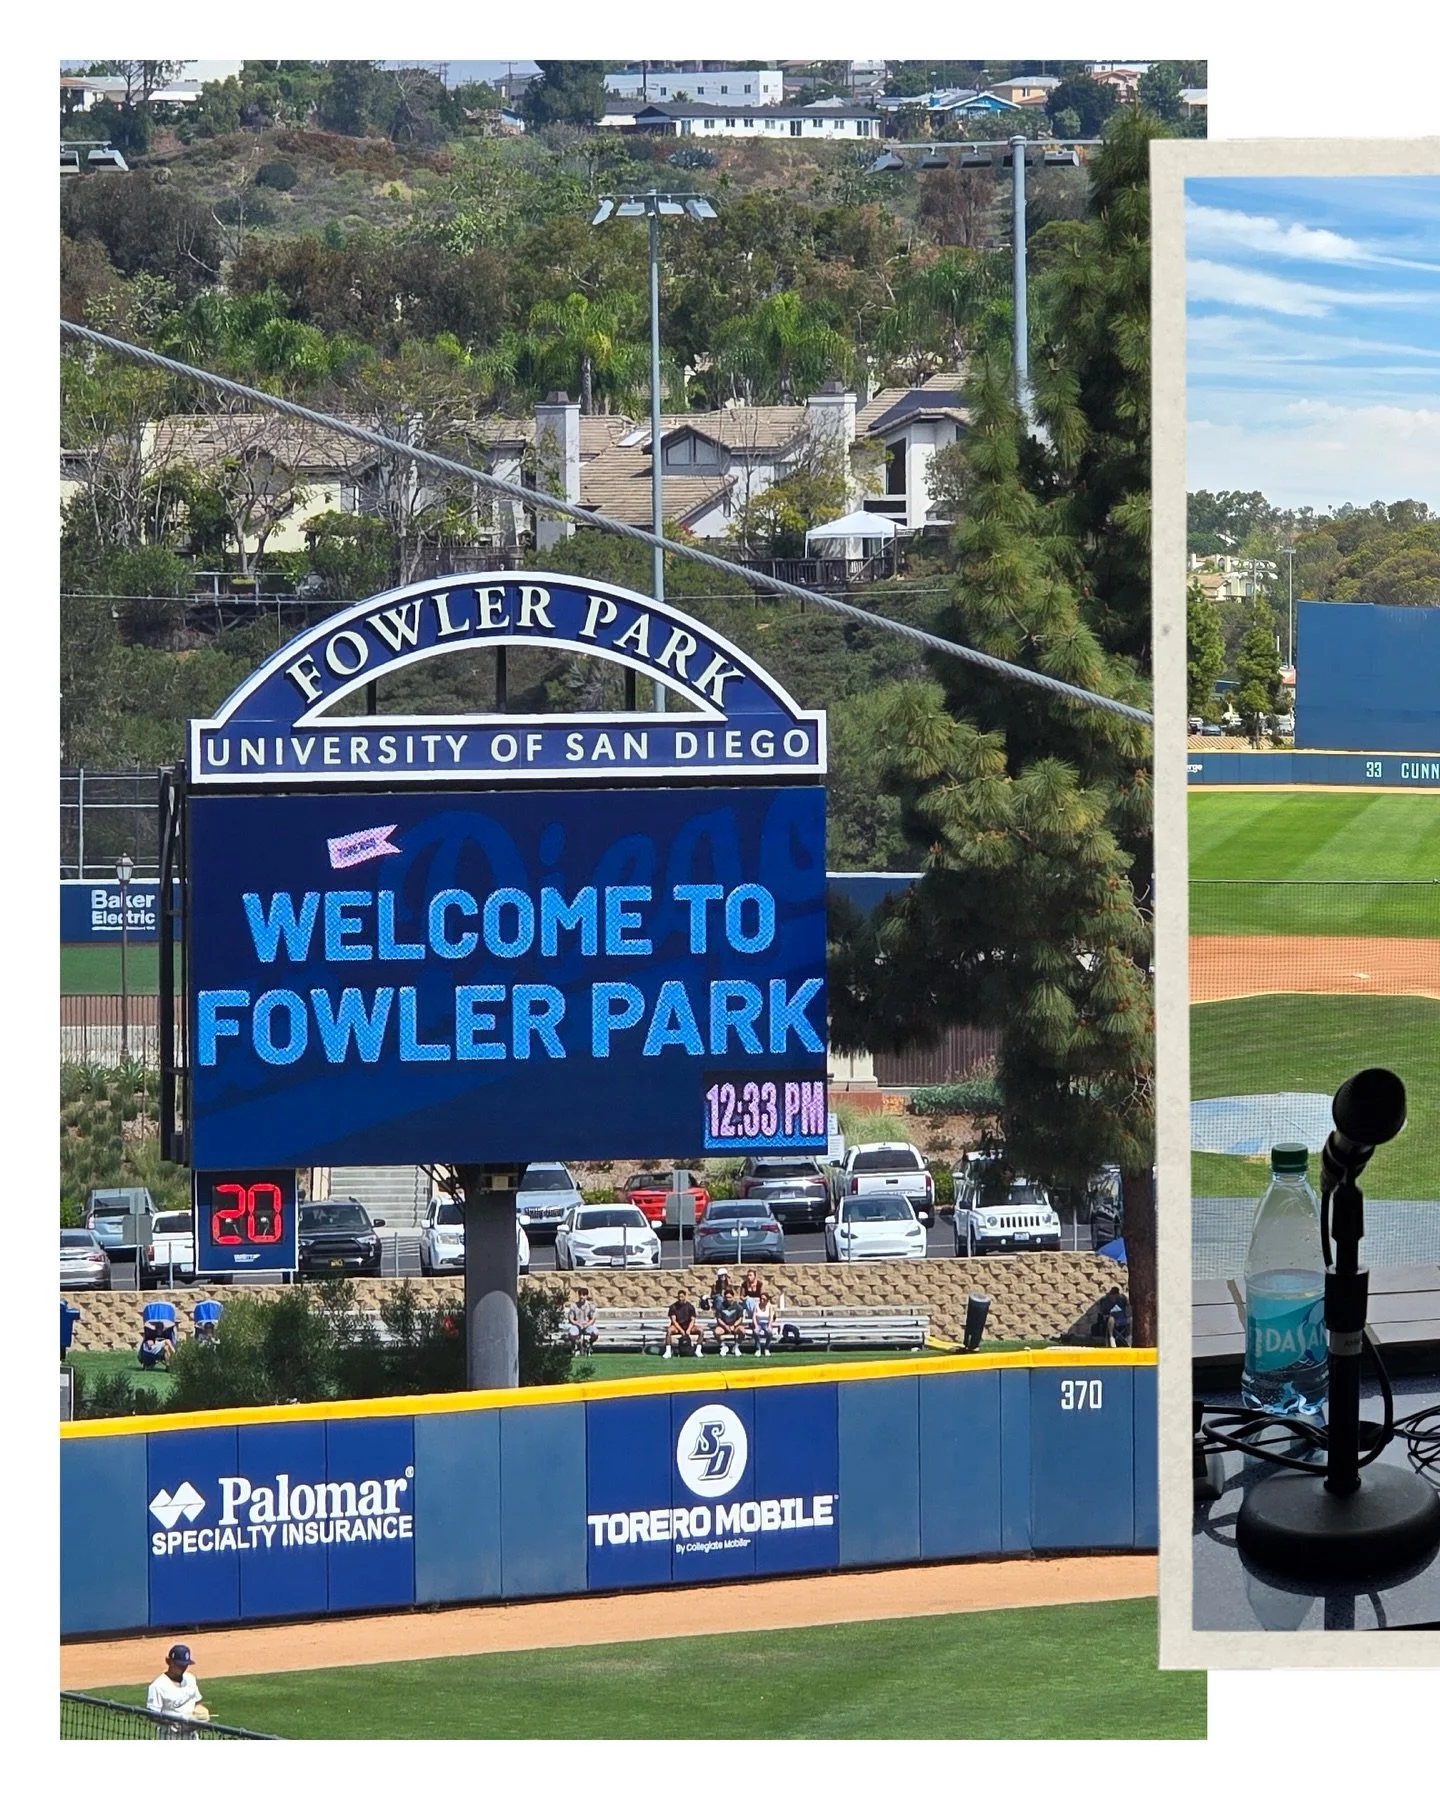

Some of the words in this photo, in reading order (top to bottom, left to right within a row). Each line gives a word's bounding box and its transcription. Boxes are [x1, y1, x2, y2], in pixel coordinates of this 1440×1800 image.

[286, 586, 556, 704] FOWLER
[578, 594, 747, 708] PARK
[206, 735, 469, 767] UNIVERSITY
[490, 734, 543, 763] OF
[565, 732, 649, 761] SAN
[675, 729, 810, 759] DIEGO
[1366, 761, 1382, 778] 33
[1401, 762, 1440, 780] CUNN
[91, 889, 156, 909] Baker
[91, 909, 156, 925] Electric
[242, 884, 653, 964] WELCOME
[672, 882, 776, 955] TO
[197, 984, 567, 1066] FOWLER
[591, 977, 826, 1058] PARK
[706, 1082, 777, 1136] 12:33
[784, 1081, 825, 1135] PM
[212, 1183, 282, 1244] 20
[1061, 1380, 1102, 1410] 370
[151, 1524, 278, 1556] SPECIALTY
[282, 1515, 413, 1546] INSURANCE
[588, 1506, 711, 1546] TORERO
[675, 1544, 686, 1554] By
[686, 1541, 723, 1553] Collegiate
